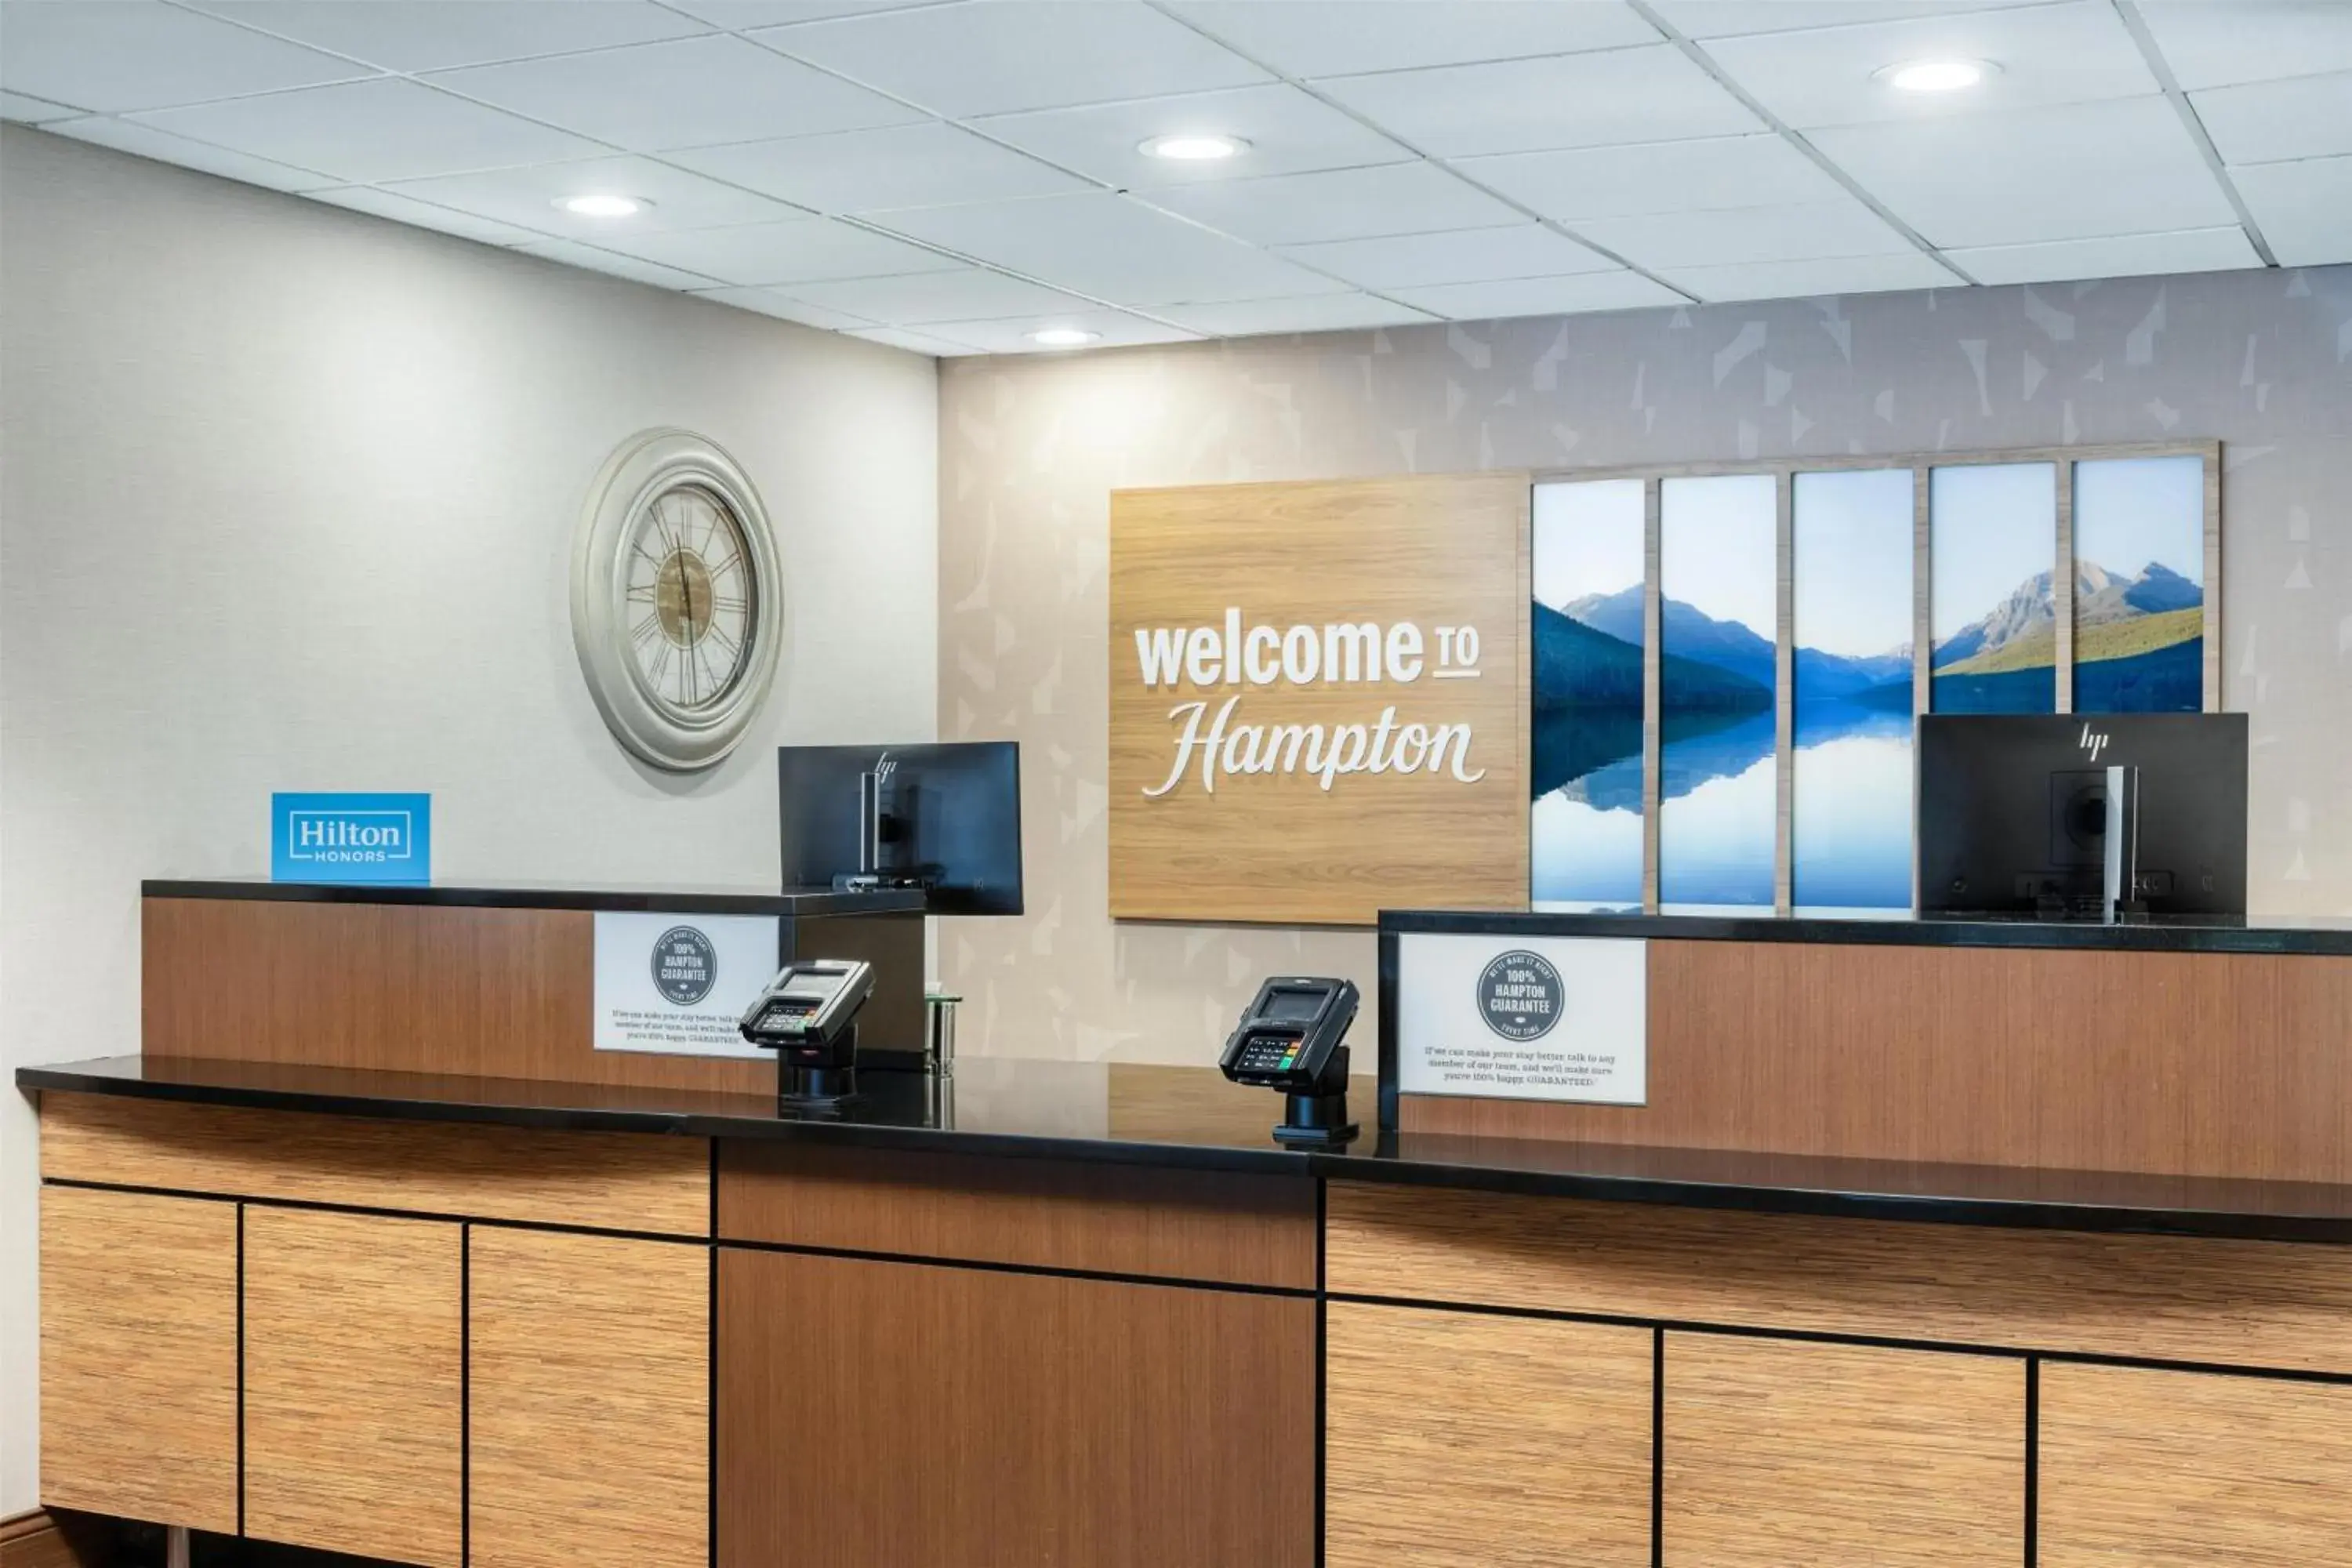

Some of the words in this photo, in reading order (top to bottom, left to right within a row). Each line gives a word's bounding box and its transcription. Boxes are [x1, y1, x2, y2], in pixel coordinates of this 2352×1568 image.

[1134, 607, 1423, 686] welcome
[1435, 626, 1480, 667] TO
[1142, 695, 1486, 797] Hampton
[300, 821, 400, 847] Hilton
[315, 851, 387, 862] HONORS
[673, 943, 695, 955] 100%
[665, 955, 703, 968] HAMPTON
[661, 968, 706, 982] GUARANTEE
[1506, 969, 1537, 982] 100%
[1495, 983, 1546, 999] HAMPTON
[1490, 998, 1551, 1014] GUARANTEE
[1567, 1052, 1586, 1062] talk
[1428, 1060, 1465, 1069] member
